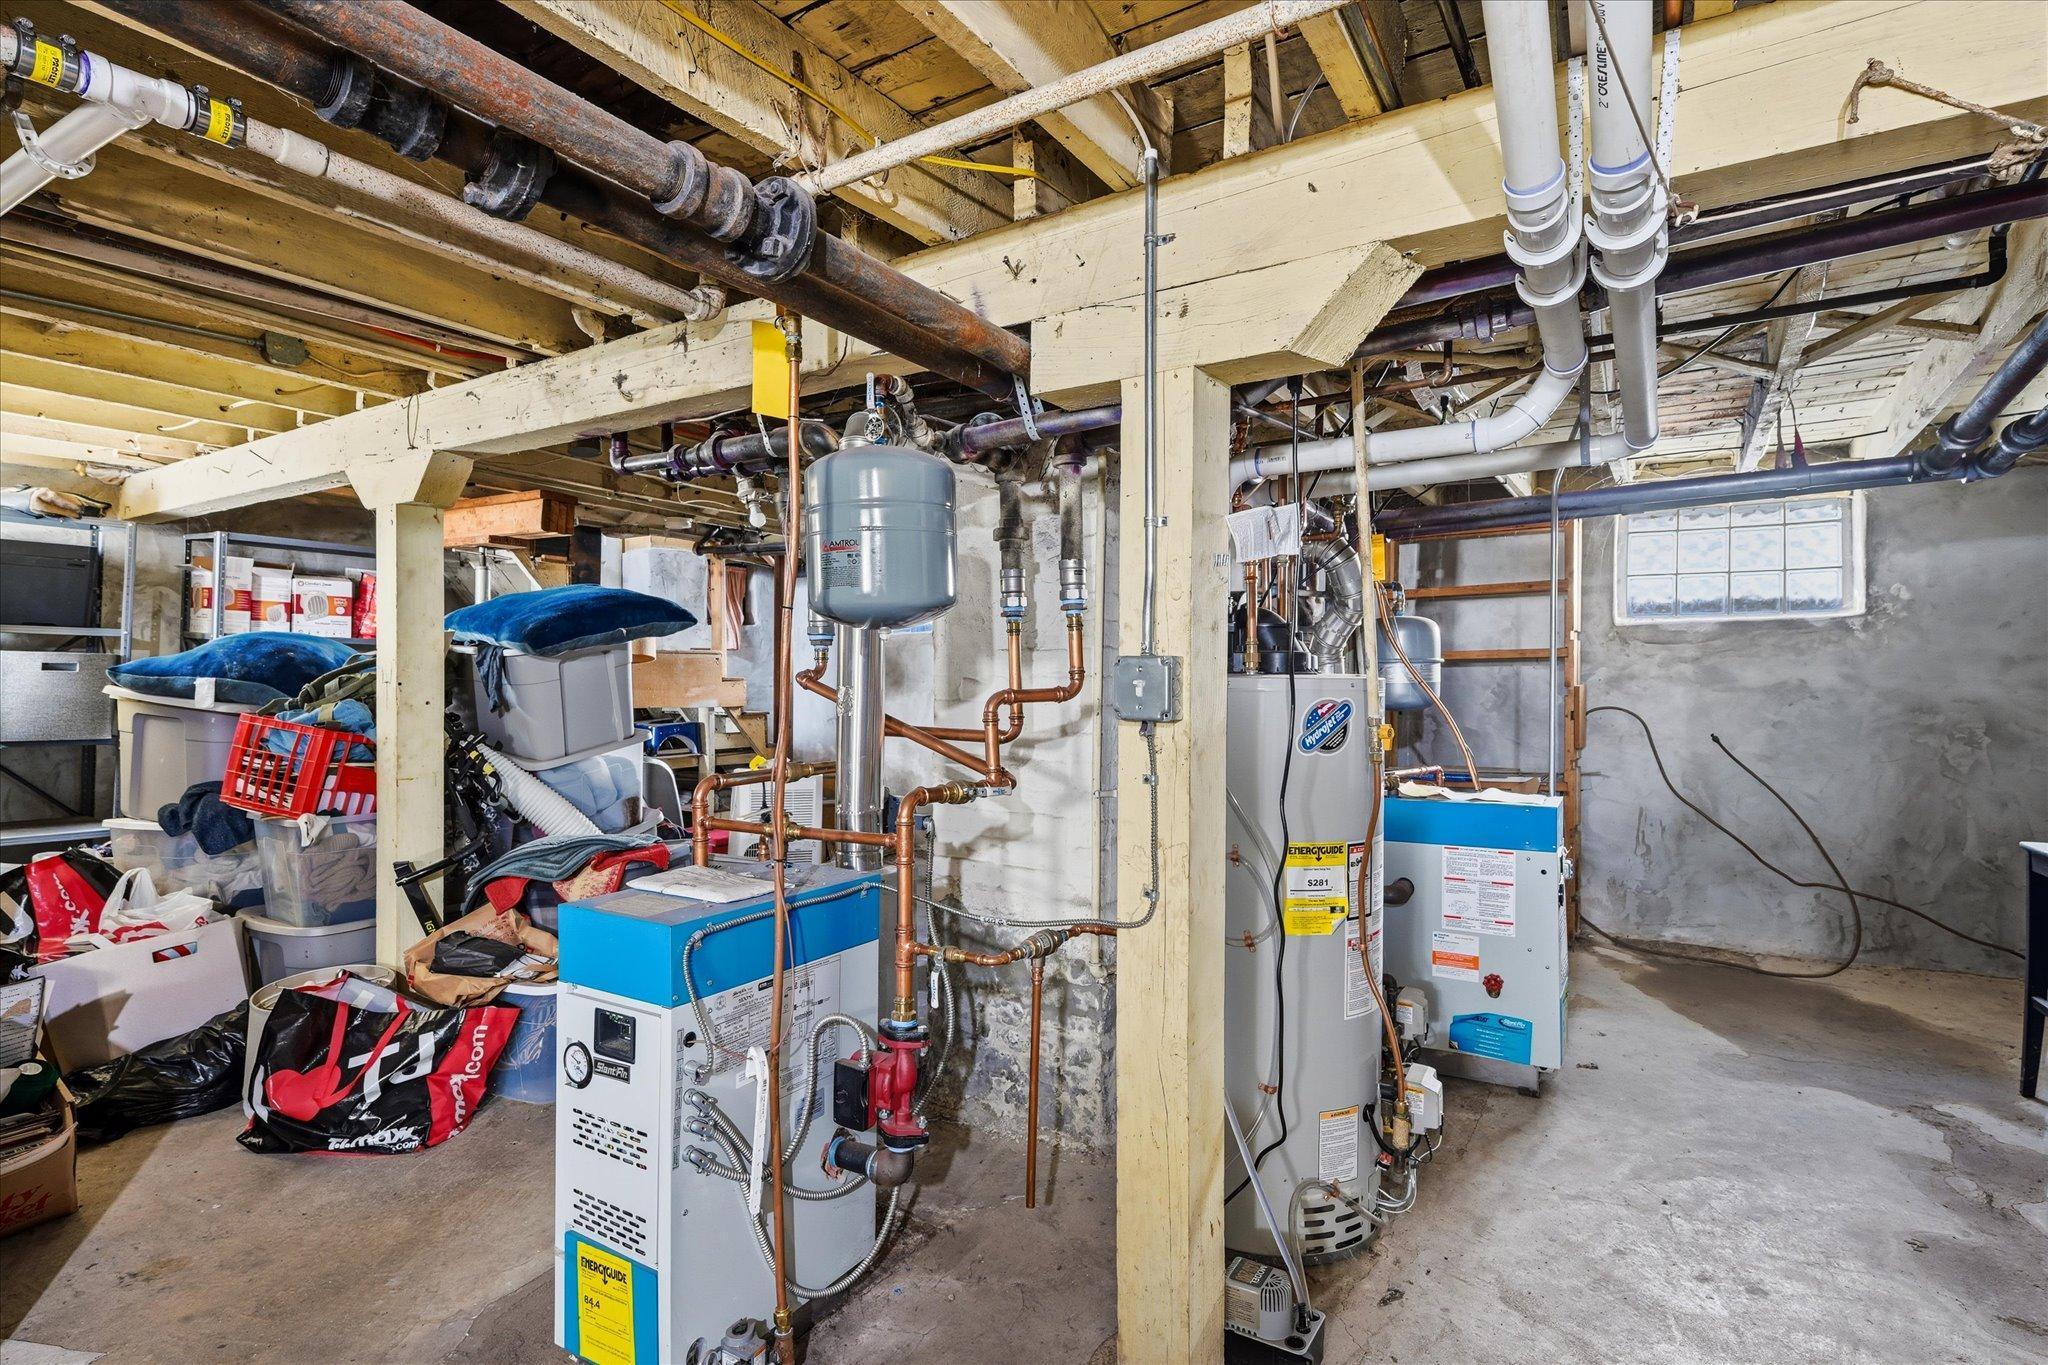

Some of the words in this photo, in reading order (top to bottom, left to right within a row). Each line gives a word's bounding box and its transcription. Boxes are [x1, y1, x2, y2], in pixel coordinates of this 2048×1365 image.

[829, 539, 860, 547] AMTROL
[1288, 845, 1344, 857] ENERGYGUIDE
[580, 1256, 628, 1285] ENERGYGUIDE
